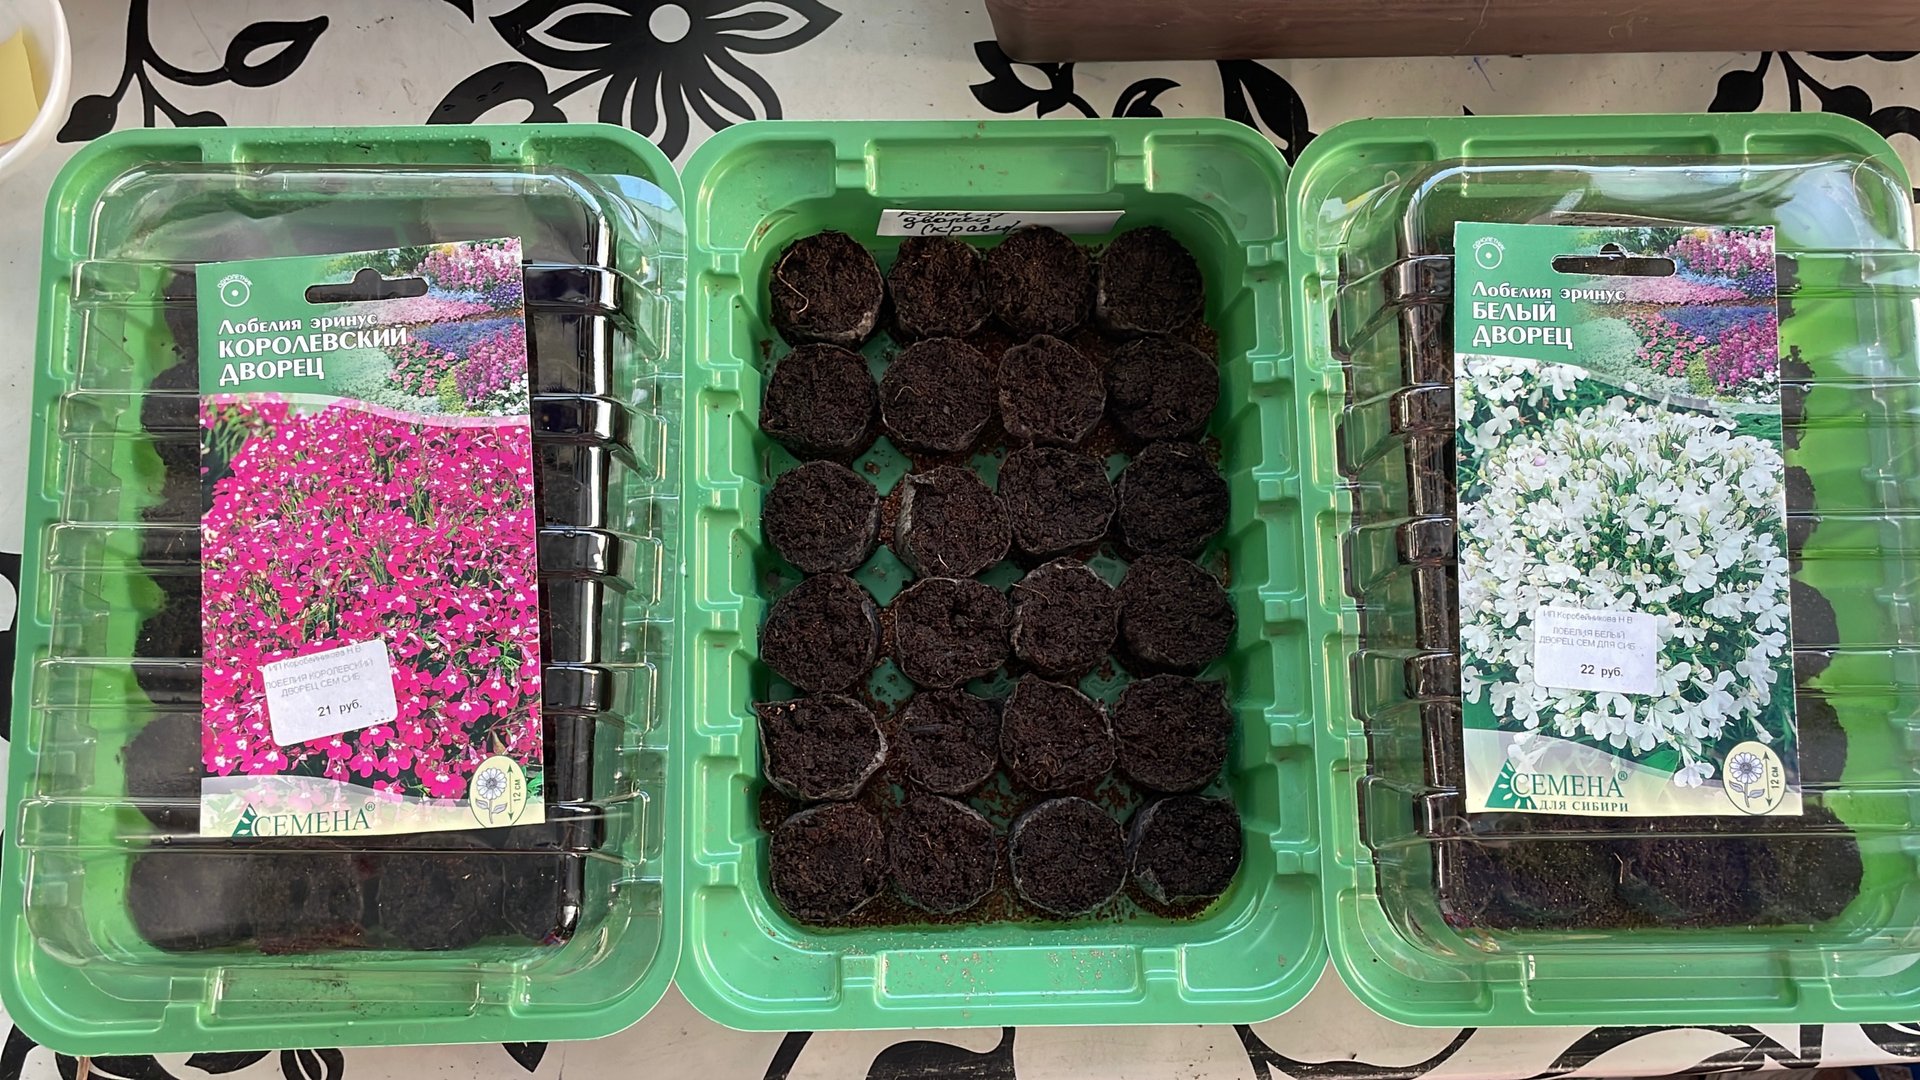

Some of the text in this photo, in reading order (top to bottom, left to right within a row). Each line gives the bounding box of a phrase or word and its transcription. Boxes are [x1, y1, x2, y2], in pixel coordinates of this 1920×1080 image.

[1472, 281, 1626, 304] Лобелия эринус
[1472, 300, 1557, 322] БЕЛЫЙ
[218, 313, 378, 336] Лобелия эринус
[218, 324, 408, 359] КОРОЛЕВСКИЙ
[1472, 325, 1575, 351] ДВОРЕЦ
[218, 356, 325, 387] ДВОРЕЦ
[1543, 610, 1556, 618] ИП
[1539, 635, 1575, 647] ДВОРЕЦ
[1576, 639, 1596, 648] СЕМ
[1596, 640, 1616, 649] ДЛЯ
[1552, 627, 1626, 640] ЛОБЕЛИЯ БЕЛЫЙ
[309, 659, 374, 681] КОРОЛЕВСКИЙ
[1580, 664, 1624, 679] 22 руб.
[281, 672, 361, 698] ДВОРЕЦ СЕМ СИБ
[317, 698, 363, 717] 21 руб.
[1511, 773, 1625, 798] СЕМЕНА
[1770, 779, 1780, 789] 12
[513, 792, 521, 802] 12
[1539, 800, 1629, 812] ДЛЯ СИБИРИ
[253, 806, 372, 837] СЕМЕНА
